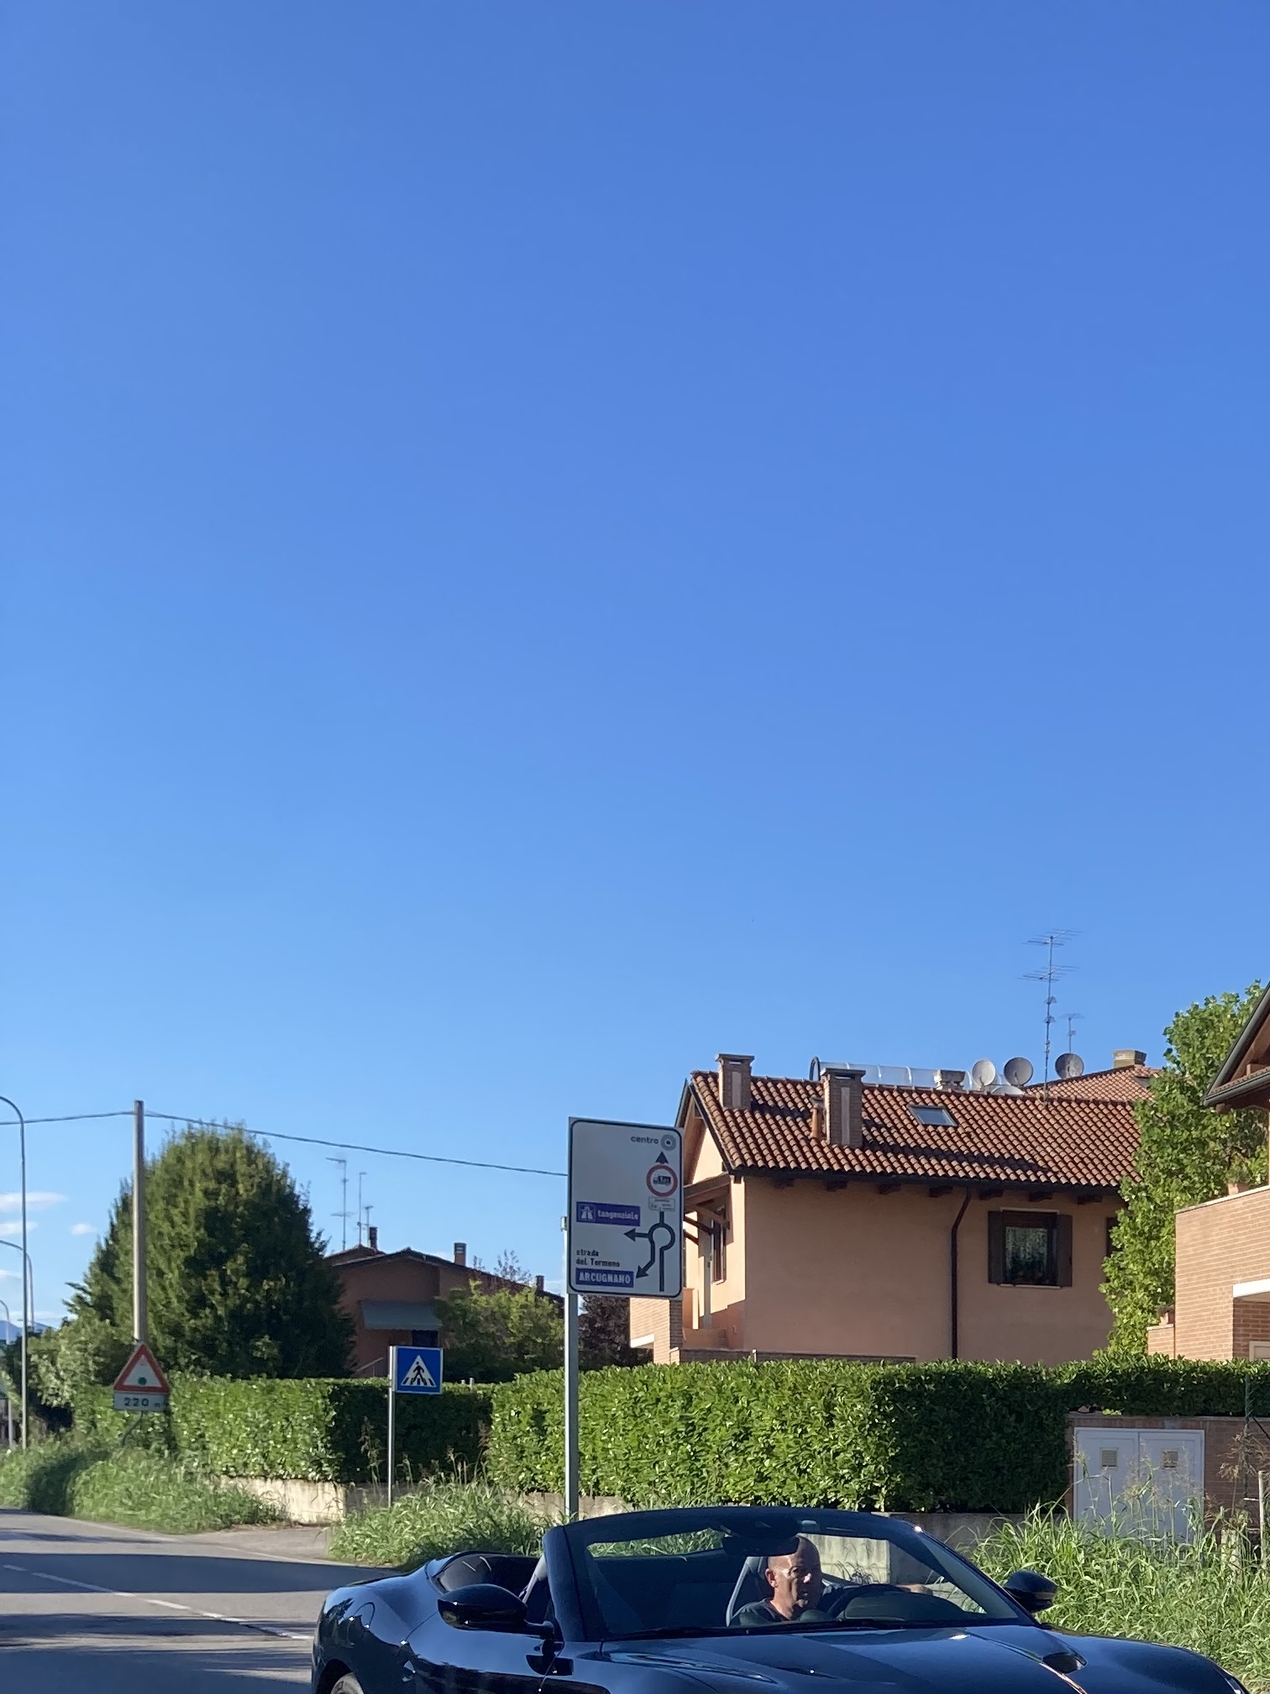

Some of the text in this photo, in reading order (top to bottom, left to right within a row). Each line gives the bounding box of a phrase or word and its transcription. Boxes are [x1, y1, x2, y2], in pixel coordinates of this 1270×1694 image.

[630, 1135, 659, 1144] centro
[597, 1209, 639, 1220] tangenziale
[576, 1248, 599, 1257] strada
[590, 1258, 620, 1267] Tormeno
[578, 1271, 631, 1284] ARCUGNANO
[123, 1397, 149, 1407] 220
